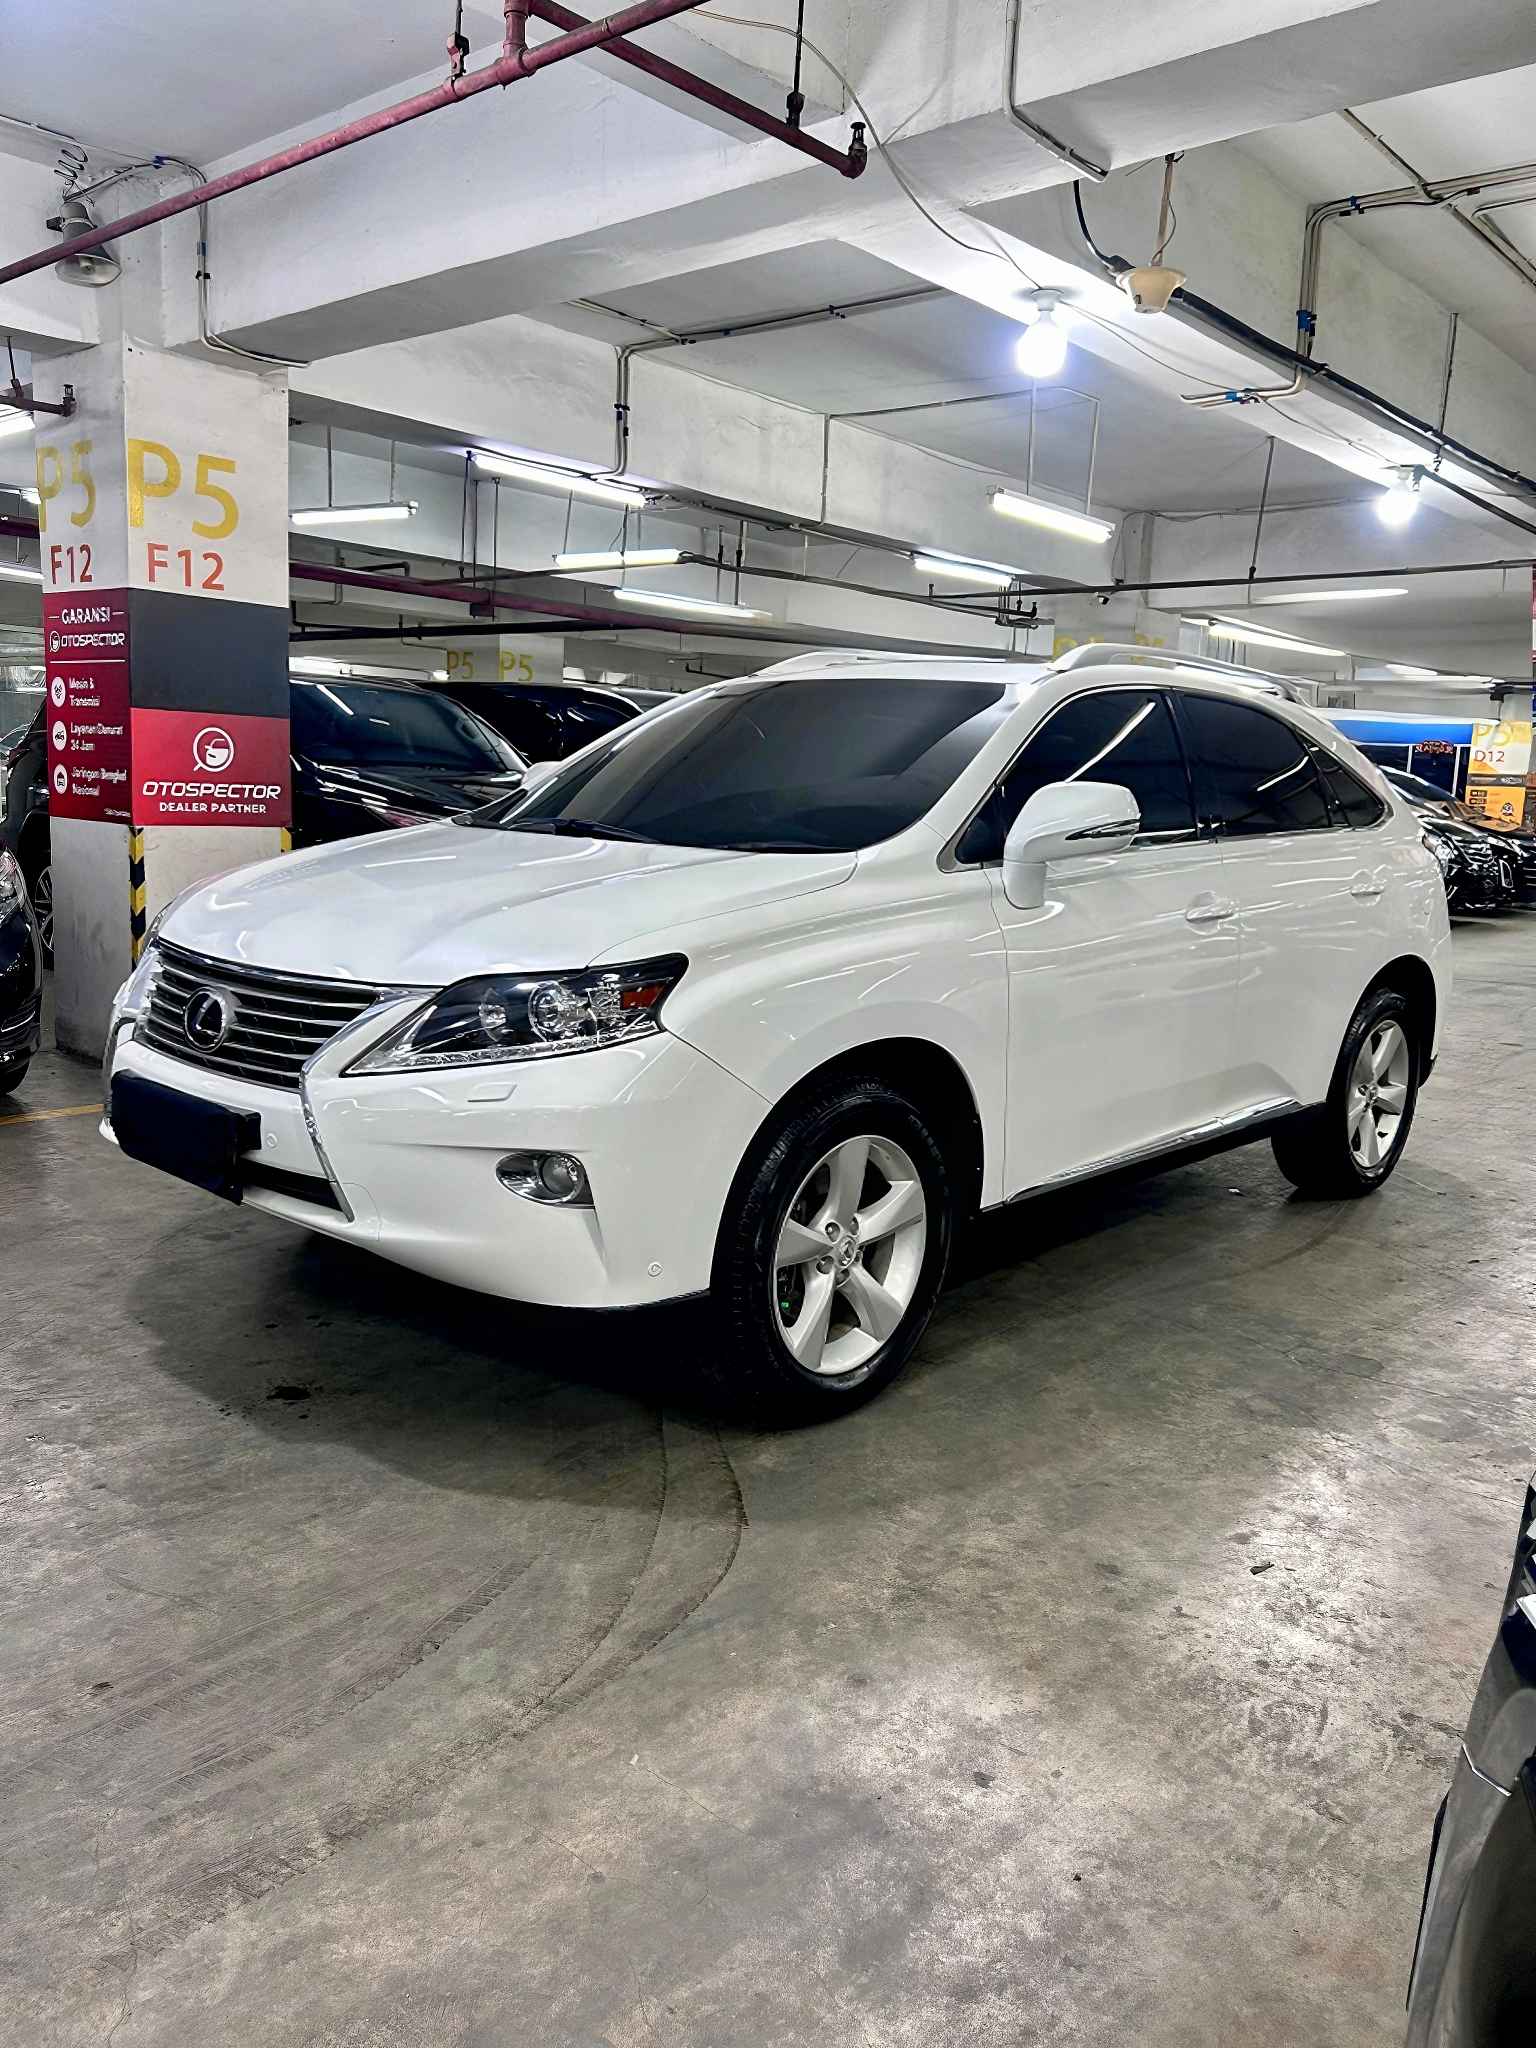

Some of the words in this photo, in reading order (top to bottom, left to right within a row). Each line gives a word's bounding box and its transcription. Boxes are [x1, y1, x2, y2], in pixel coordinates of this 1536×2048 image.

[36, 440, 96, 532] P5
[127, 438, 239, 540] P5
[50, 544, 93, 585] F12
[147, 542, 225, 591] F12
[62, 607, 111, 624] GARANSI
[61, 633, 125, 647] OTOSPECTOR
[447, 650, 475, 680] P5
[498, 651, 534, 682] P5
[1475, 750, 1505, 763] D12
[142, 781, 281, 799] OTOSPECTOR
[159, 802, 208, 813] DEALER
[211, 803, 267, 814] PARTNER
